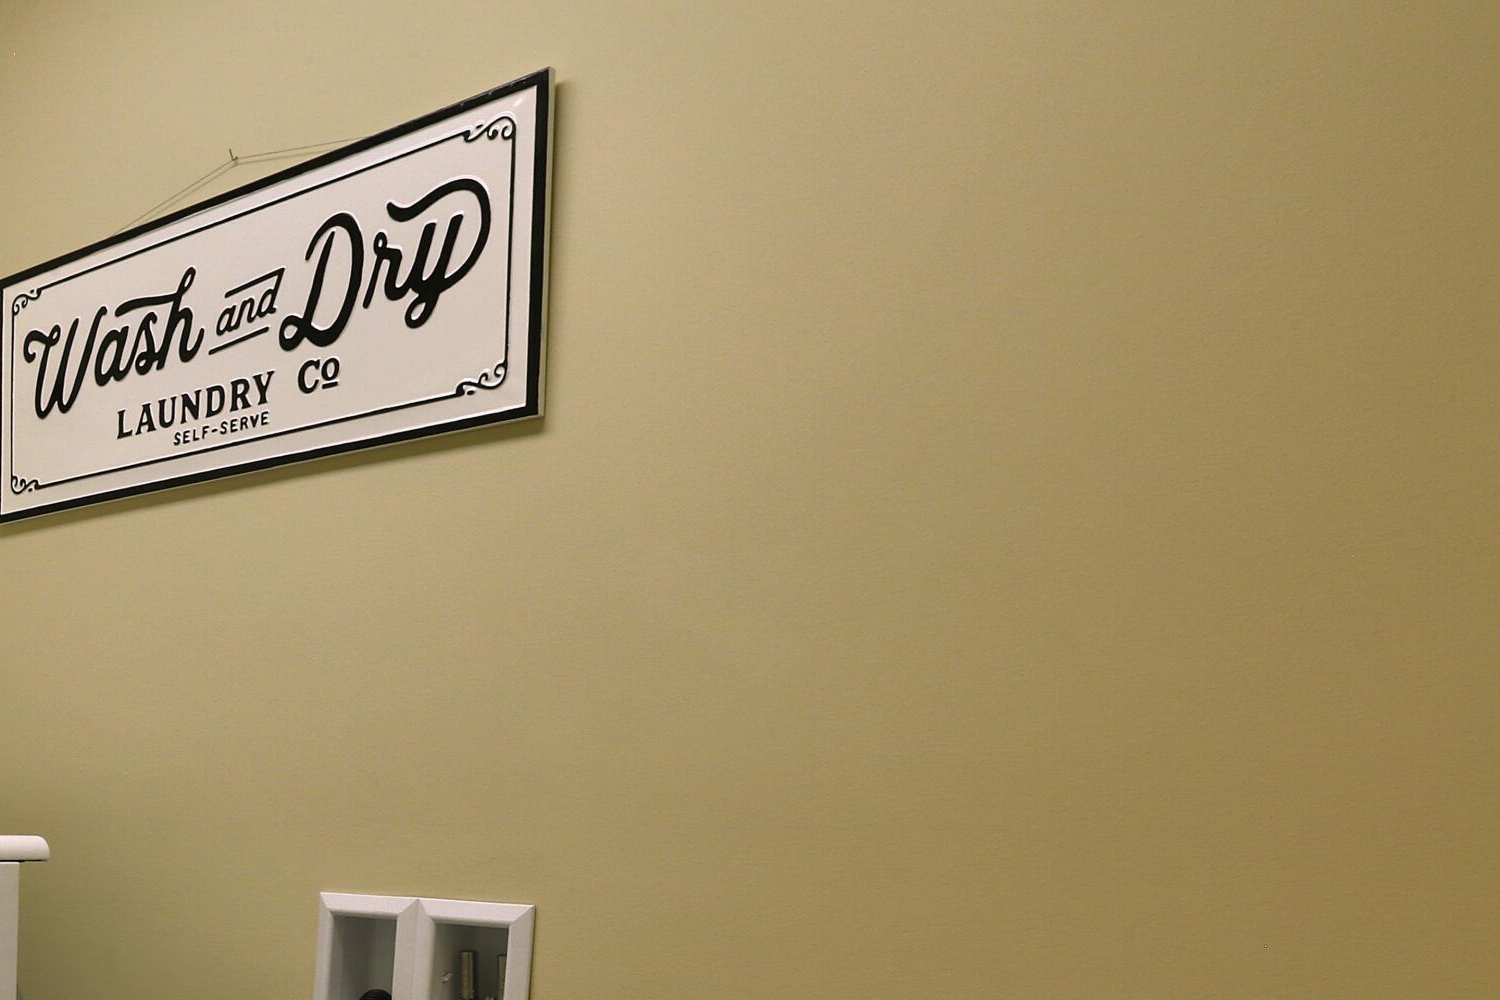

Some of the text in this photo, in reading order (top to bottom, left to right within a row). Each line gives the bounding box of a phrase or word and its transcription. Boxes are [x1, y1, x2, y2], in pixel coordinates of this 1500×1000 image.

[23, 178, 491, 420] Wash and Dry
[116, 370, 275, 440] LAUNDRY
[173, 411, 270, 446] SELF-SERVE
